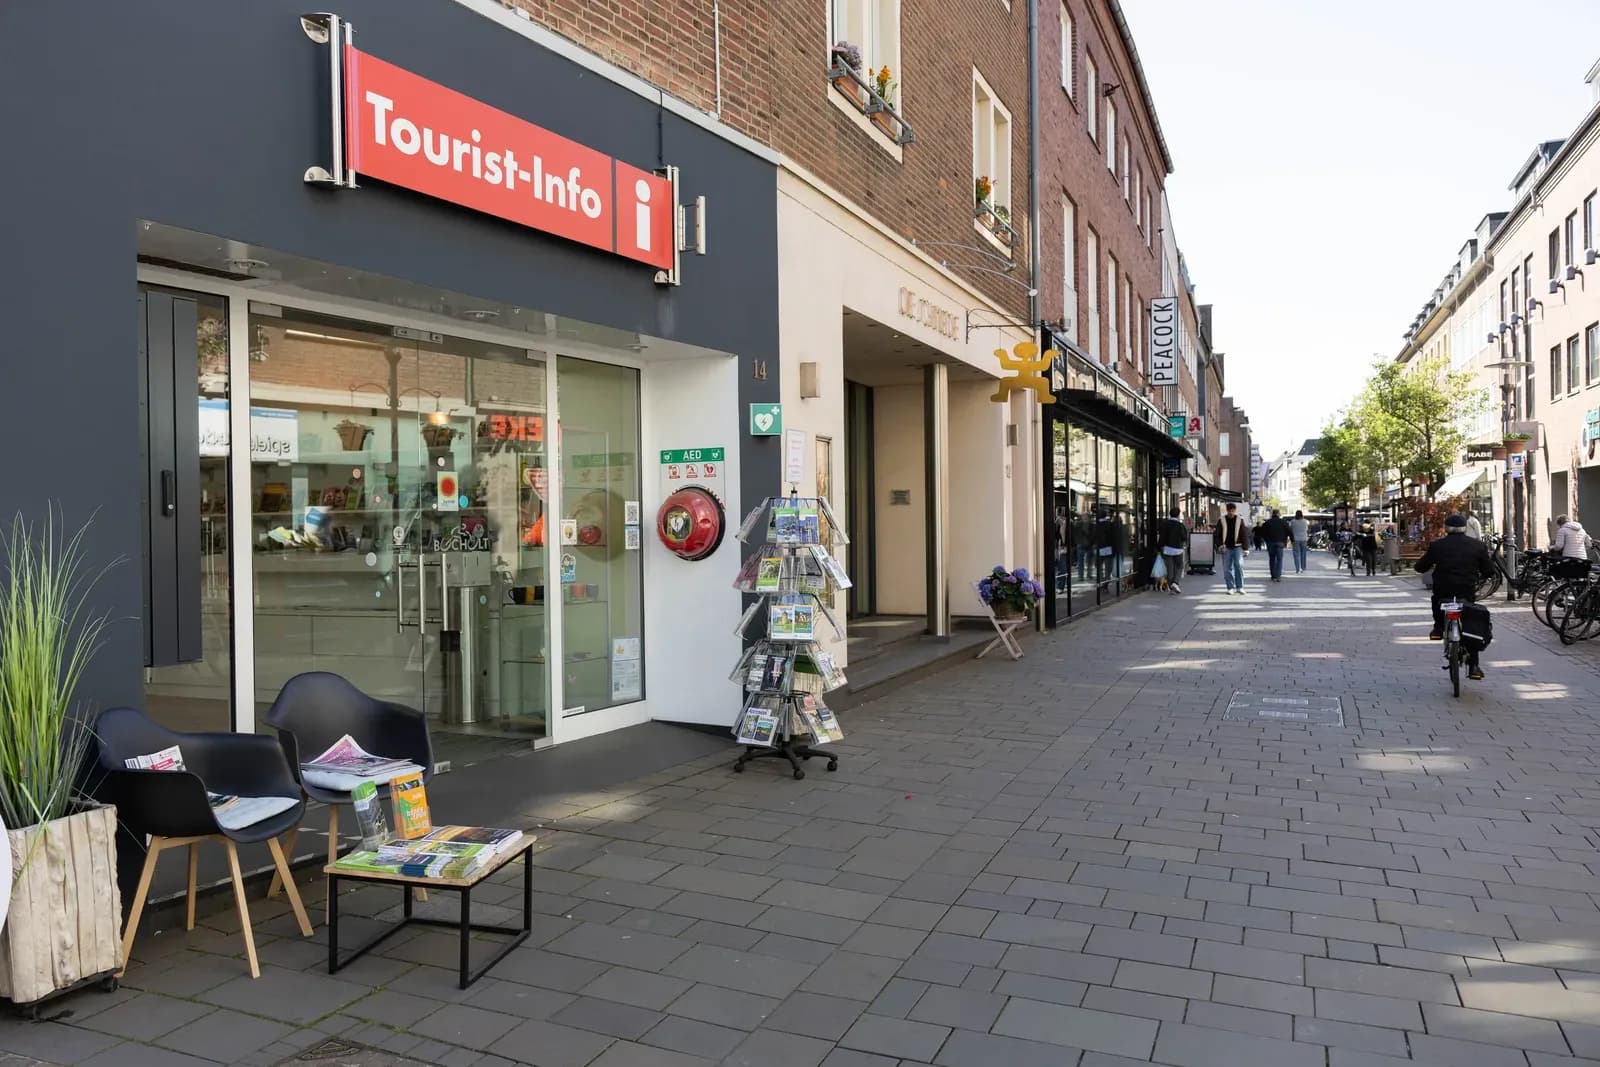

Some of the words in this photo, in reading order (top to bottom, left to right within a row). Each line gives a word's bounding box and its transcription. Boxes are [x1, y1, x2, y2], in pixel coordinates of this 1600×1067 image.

[366, 91, 602, 219] Tourist-Info
[1154, 302, 1173, 381] PEACOCK
[753, 359, 768, 380] 14
[682, 450, 702, 461] AED
